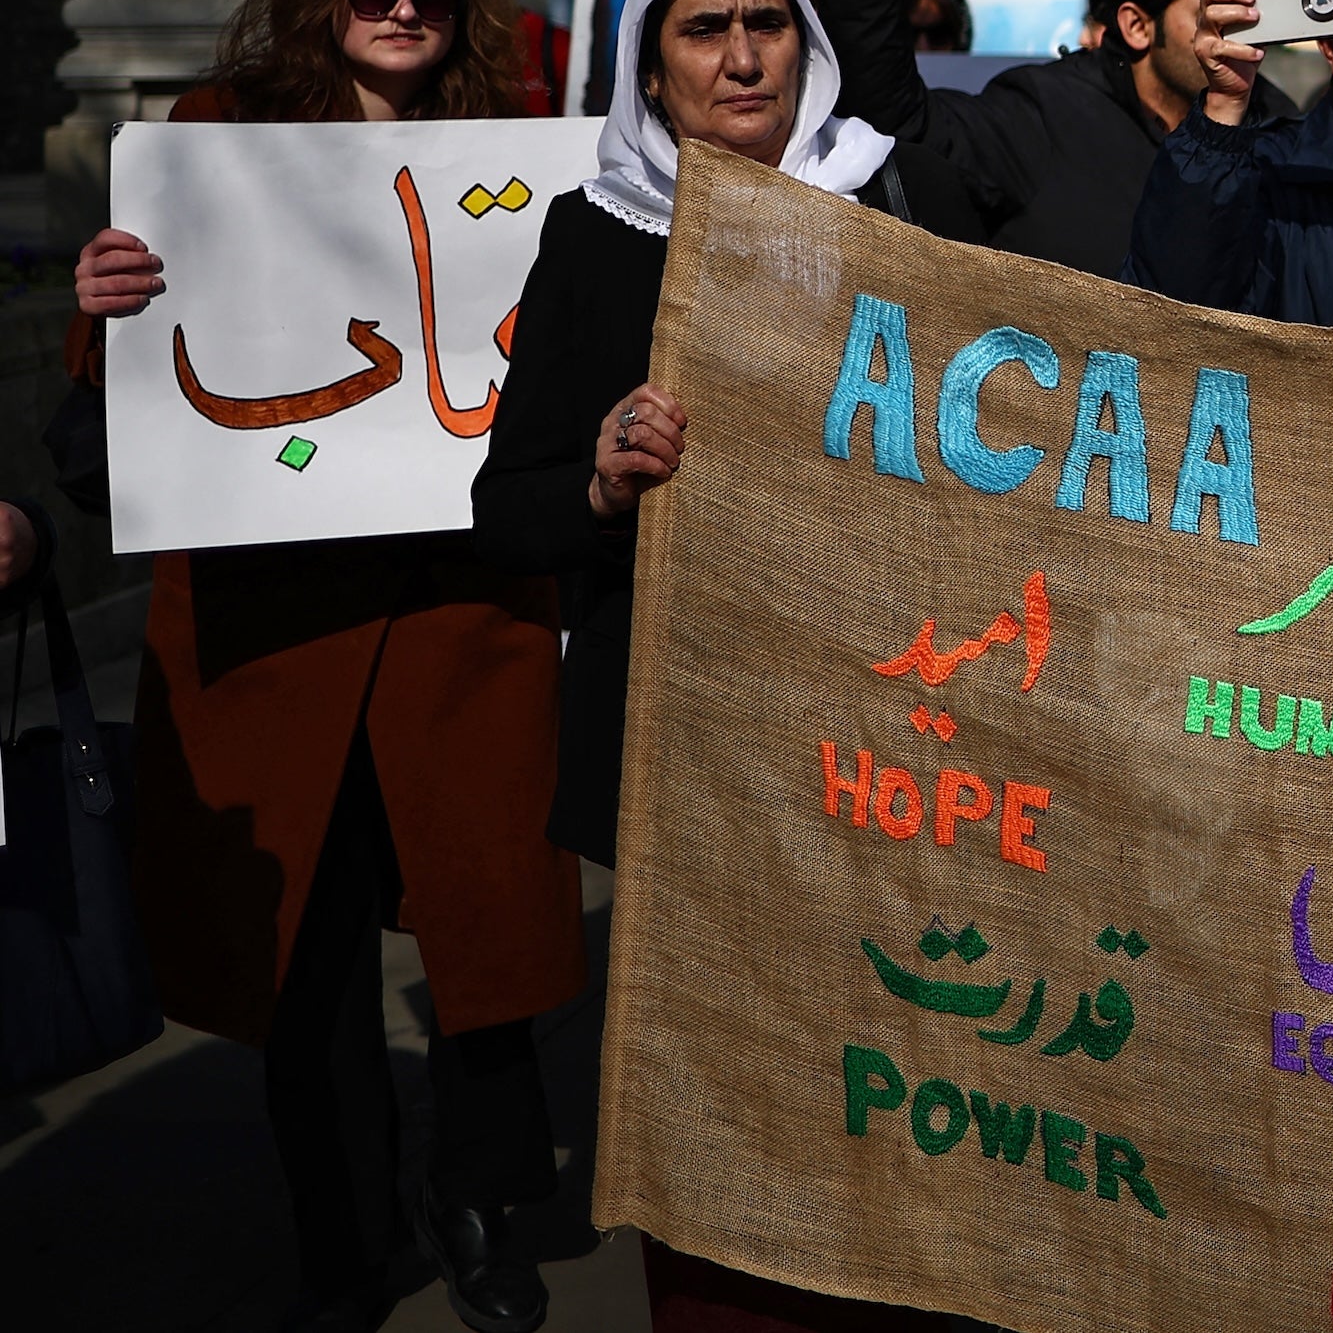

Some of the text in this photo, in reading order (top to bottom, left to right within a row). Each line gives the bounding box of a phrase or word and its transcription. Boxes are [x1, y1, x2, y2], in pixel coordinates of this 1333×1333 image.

[174, 166, 533, 472] تاب
[823, 294, 1260, 546] ACAA
[871, 570, 1051, 742] امید
[820, 740, 1051, 873] HOPE
[860, 923, 1151, 1062] قدرت
[842, 1043, 1168, 1220] POWER
